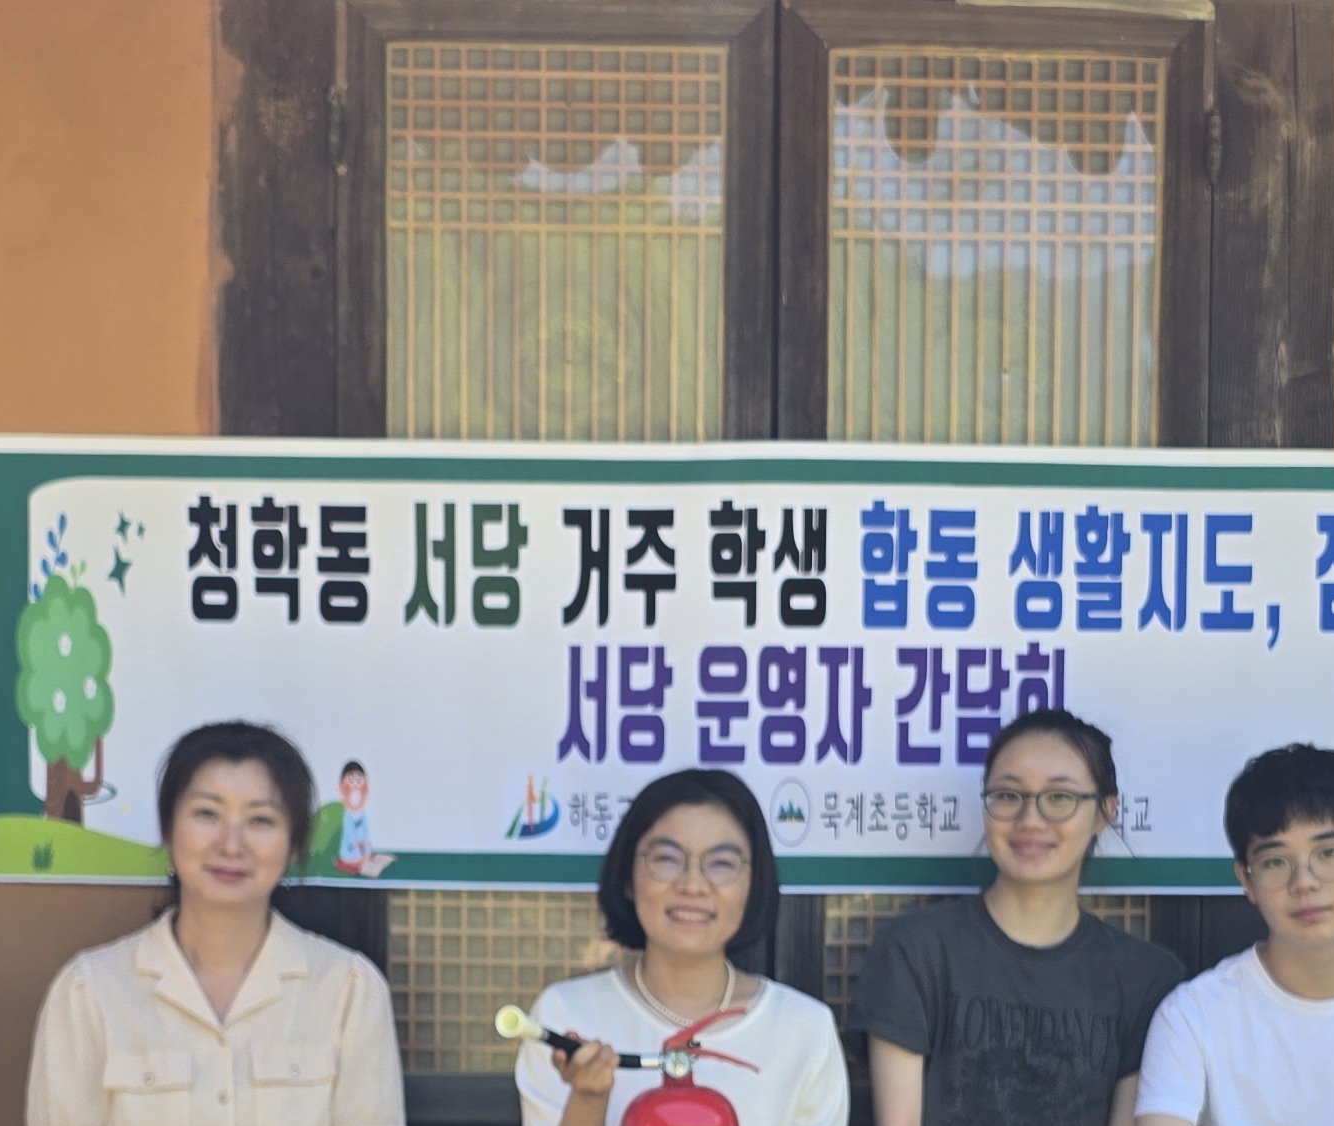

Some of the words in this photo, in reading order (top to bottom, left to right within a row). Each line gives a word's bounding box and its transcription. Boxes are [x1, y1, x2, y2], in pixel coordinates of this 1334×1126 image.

[188, 496, 370, 624] 청학동
[405, 503, 528, 627] 서당
[563, 509, 676, 627] 거주
[709, 500, 827, 628] 학생
[861, 500, 978, 630] 합동
[1008, 505, 1280, 649] 생활지도,
[558, 646, 673, 764] 서당
[696, 646, 872, 764] 운영자
[820, 791, 961, 841] 묵계초등학교
